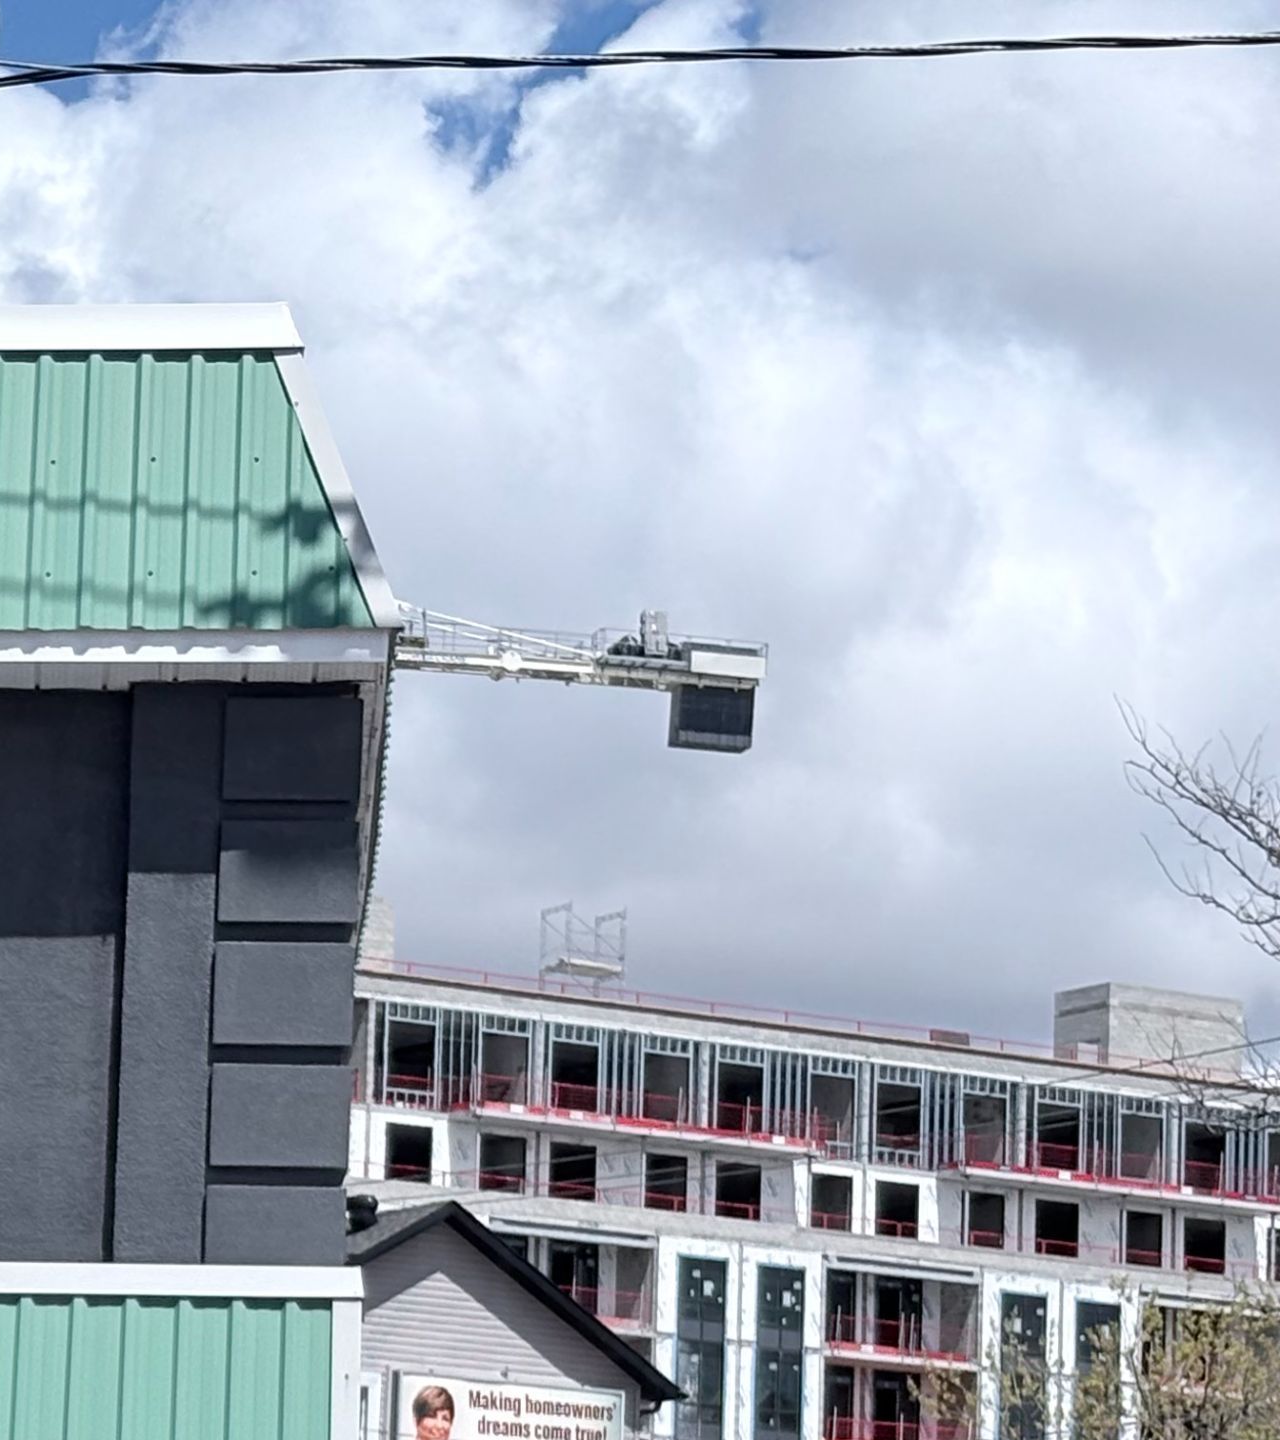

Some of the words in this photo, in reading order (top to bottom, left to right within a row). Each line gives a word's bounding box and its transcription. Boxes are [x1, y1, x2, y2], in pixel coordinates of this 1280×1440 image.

[468, 1389, 522, 1418] Making
[525, 1394, 617, 1422] homeowners'
[477, 1415, 531, 1439] dreams
